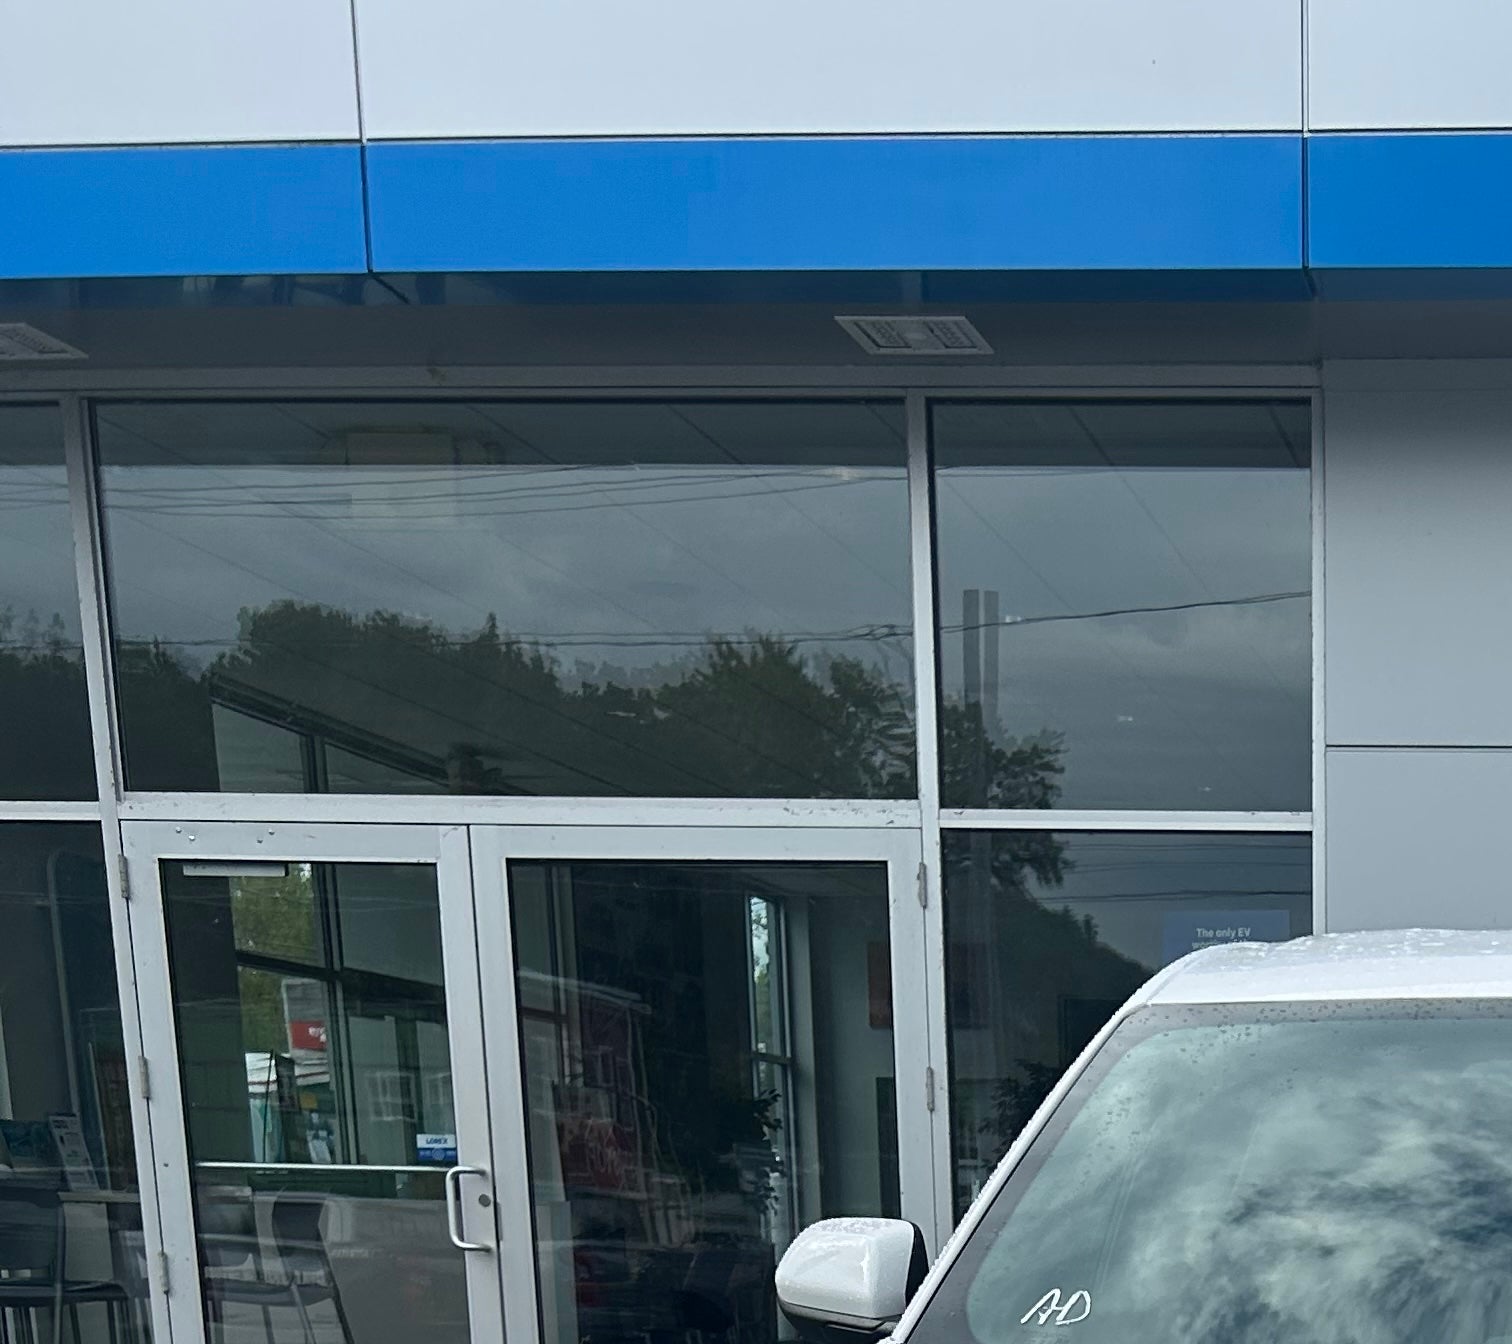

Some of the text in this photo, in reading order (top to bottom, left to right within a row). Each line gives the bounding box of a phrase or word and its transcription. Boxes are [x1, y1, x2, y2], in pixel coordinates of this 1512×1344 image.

[1196, 927, 1251, 939] The only EV
